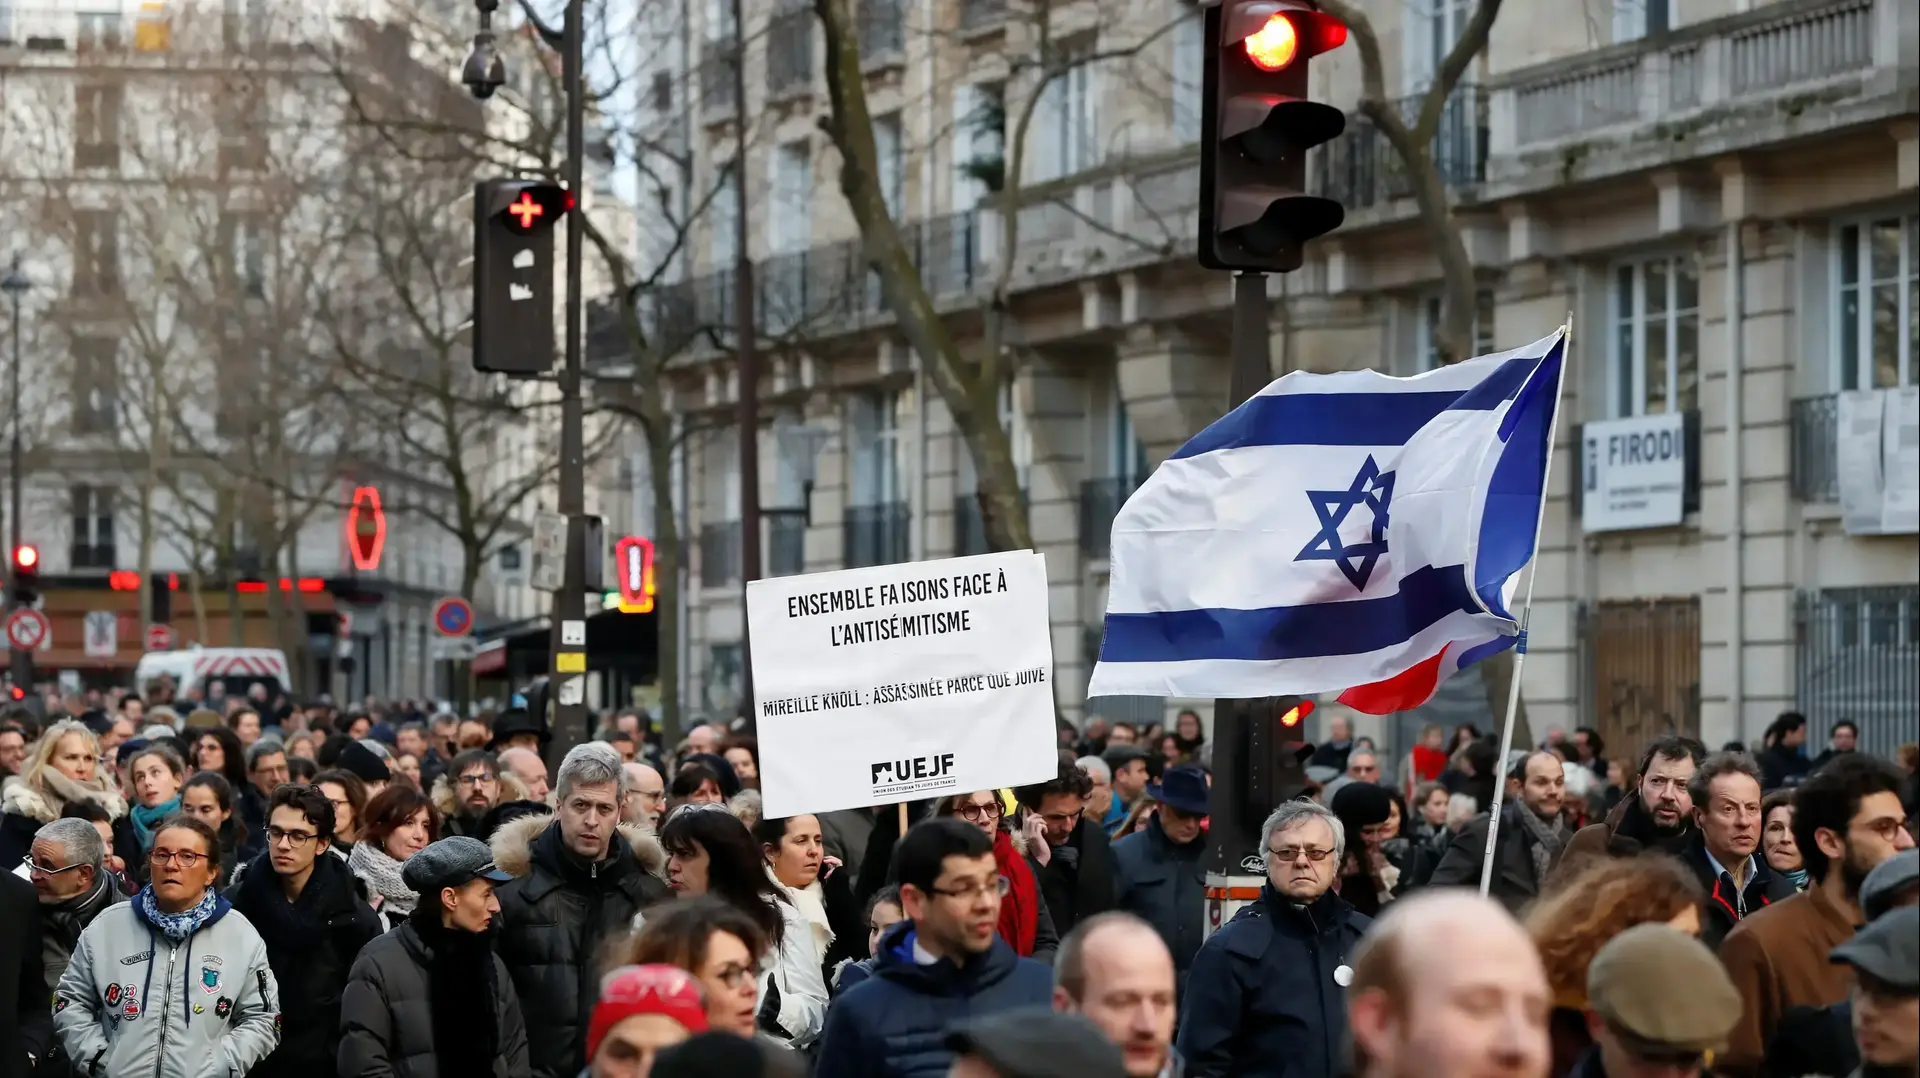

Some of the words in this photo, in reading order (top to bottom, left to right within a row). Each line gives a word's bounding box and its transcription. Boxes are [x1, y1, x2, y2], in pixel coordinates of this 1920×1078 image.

[787, 586, 875, 618] ENSEMBLE
[954, 572, 992, 598] FACE
[997, 568, 1008, 592] À
[763, 695, 819, 717] MIREILLE
[822, 689, 862, 710] KNOLL
[873, 678, 944, 704] ASSASSINÉE
[946, 673, 985, 695] PARCE
[987, 671, 1011, 690] QUE
[1014, 667, 1045, 686] JUIVE
[895, 753, 954, 781] UEJF
